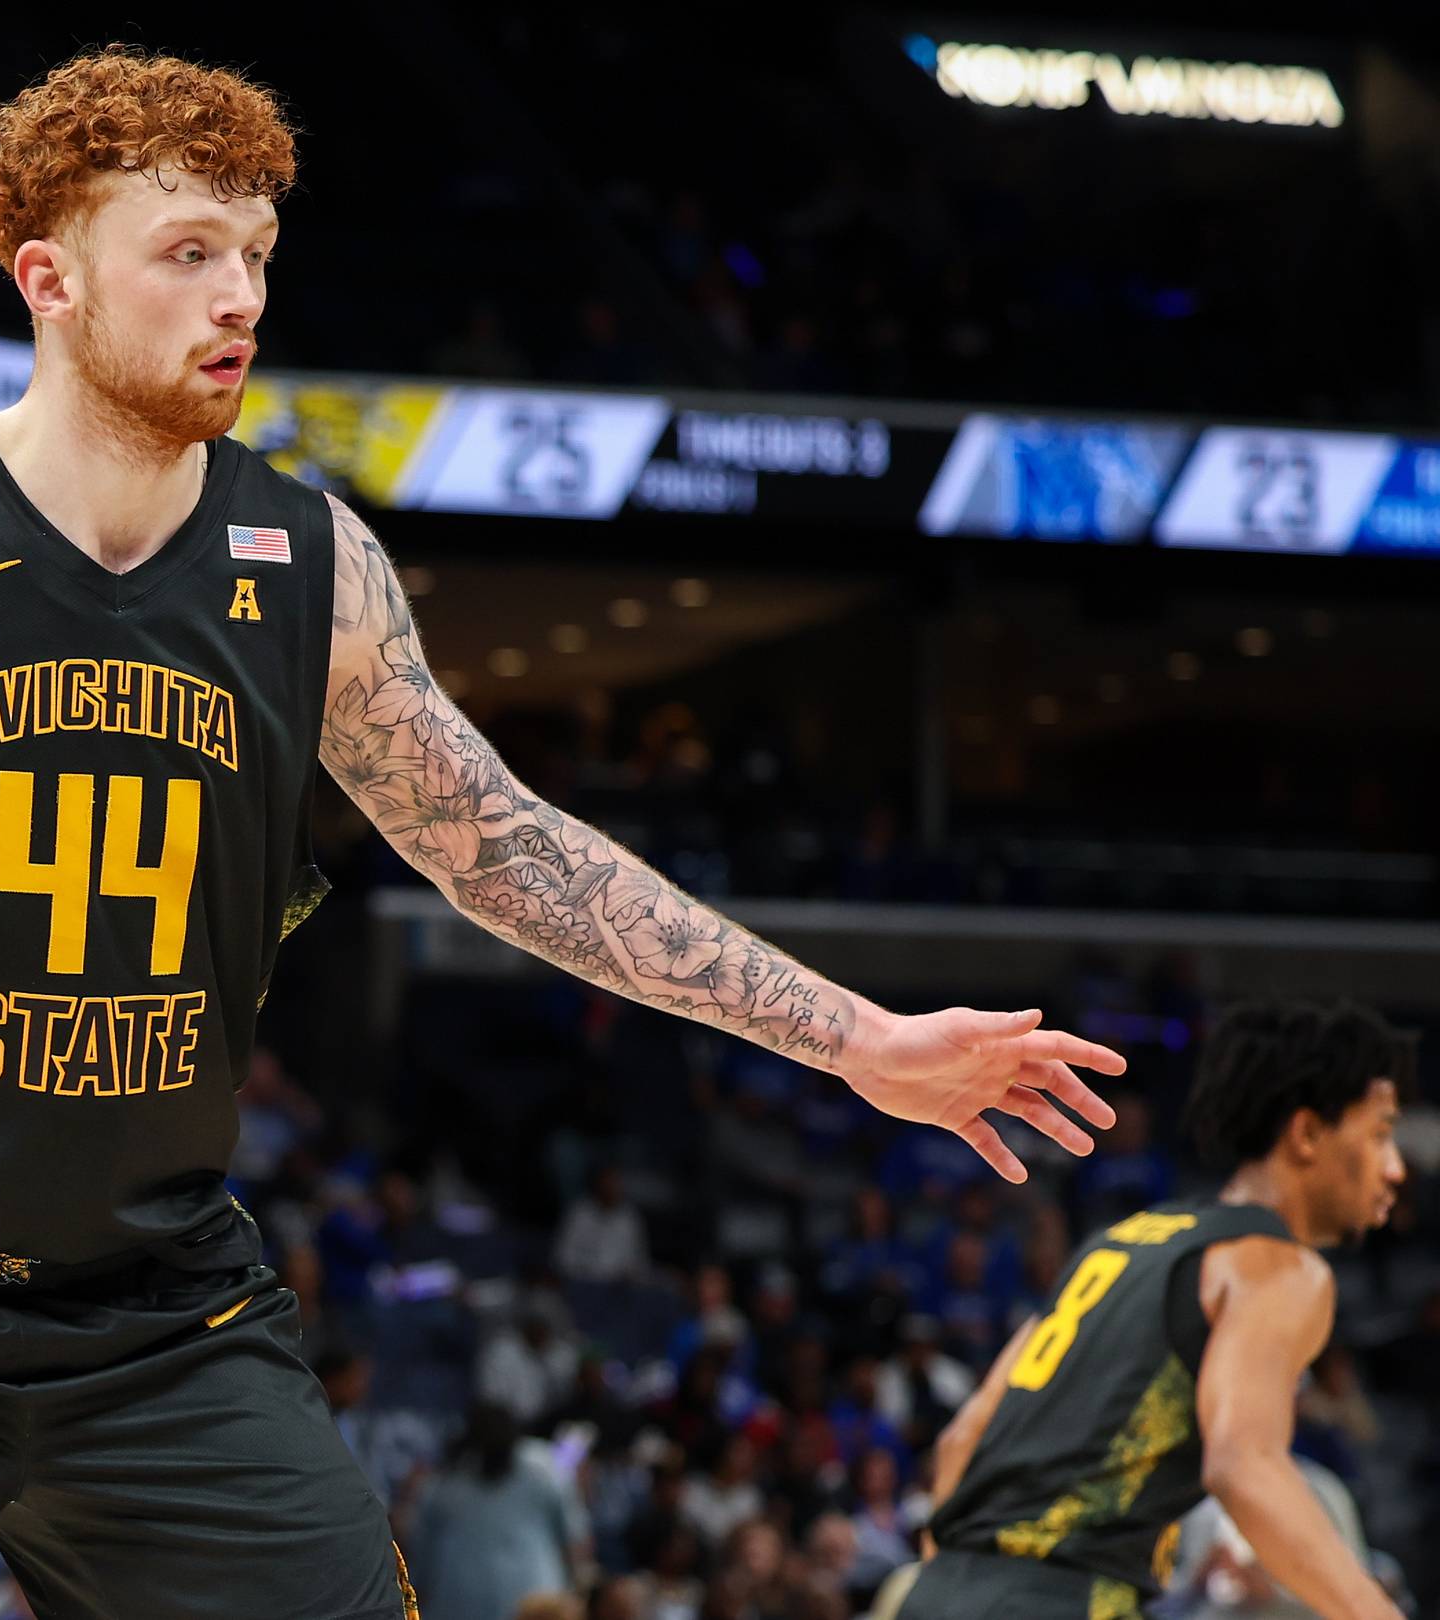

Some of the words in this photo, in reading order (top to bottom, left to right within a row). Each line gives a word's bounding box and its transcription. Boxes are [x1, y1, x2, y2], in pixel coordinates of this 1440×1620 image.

[228, 578, 262, 621] A
[763, 967, 819, 1008] You
[1008, 1248, 1131, 1392] 8
